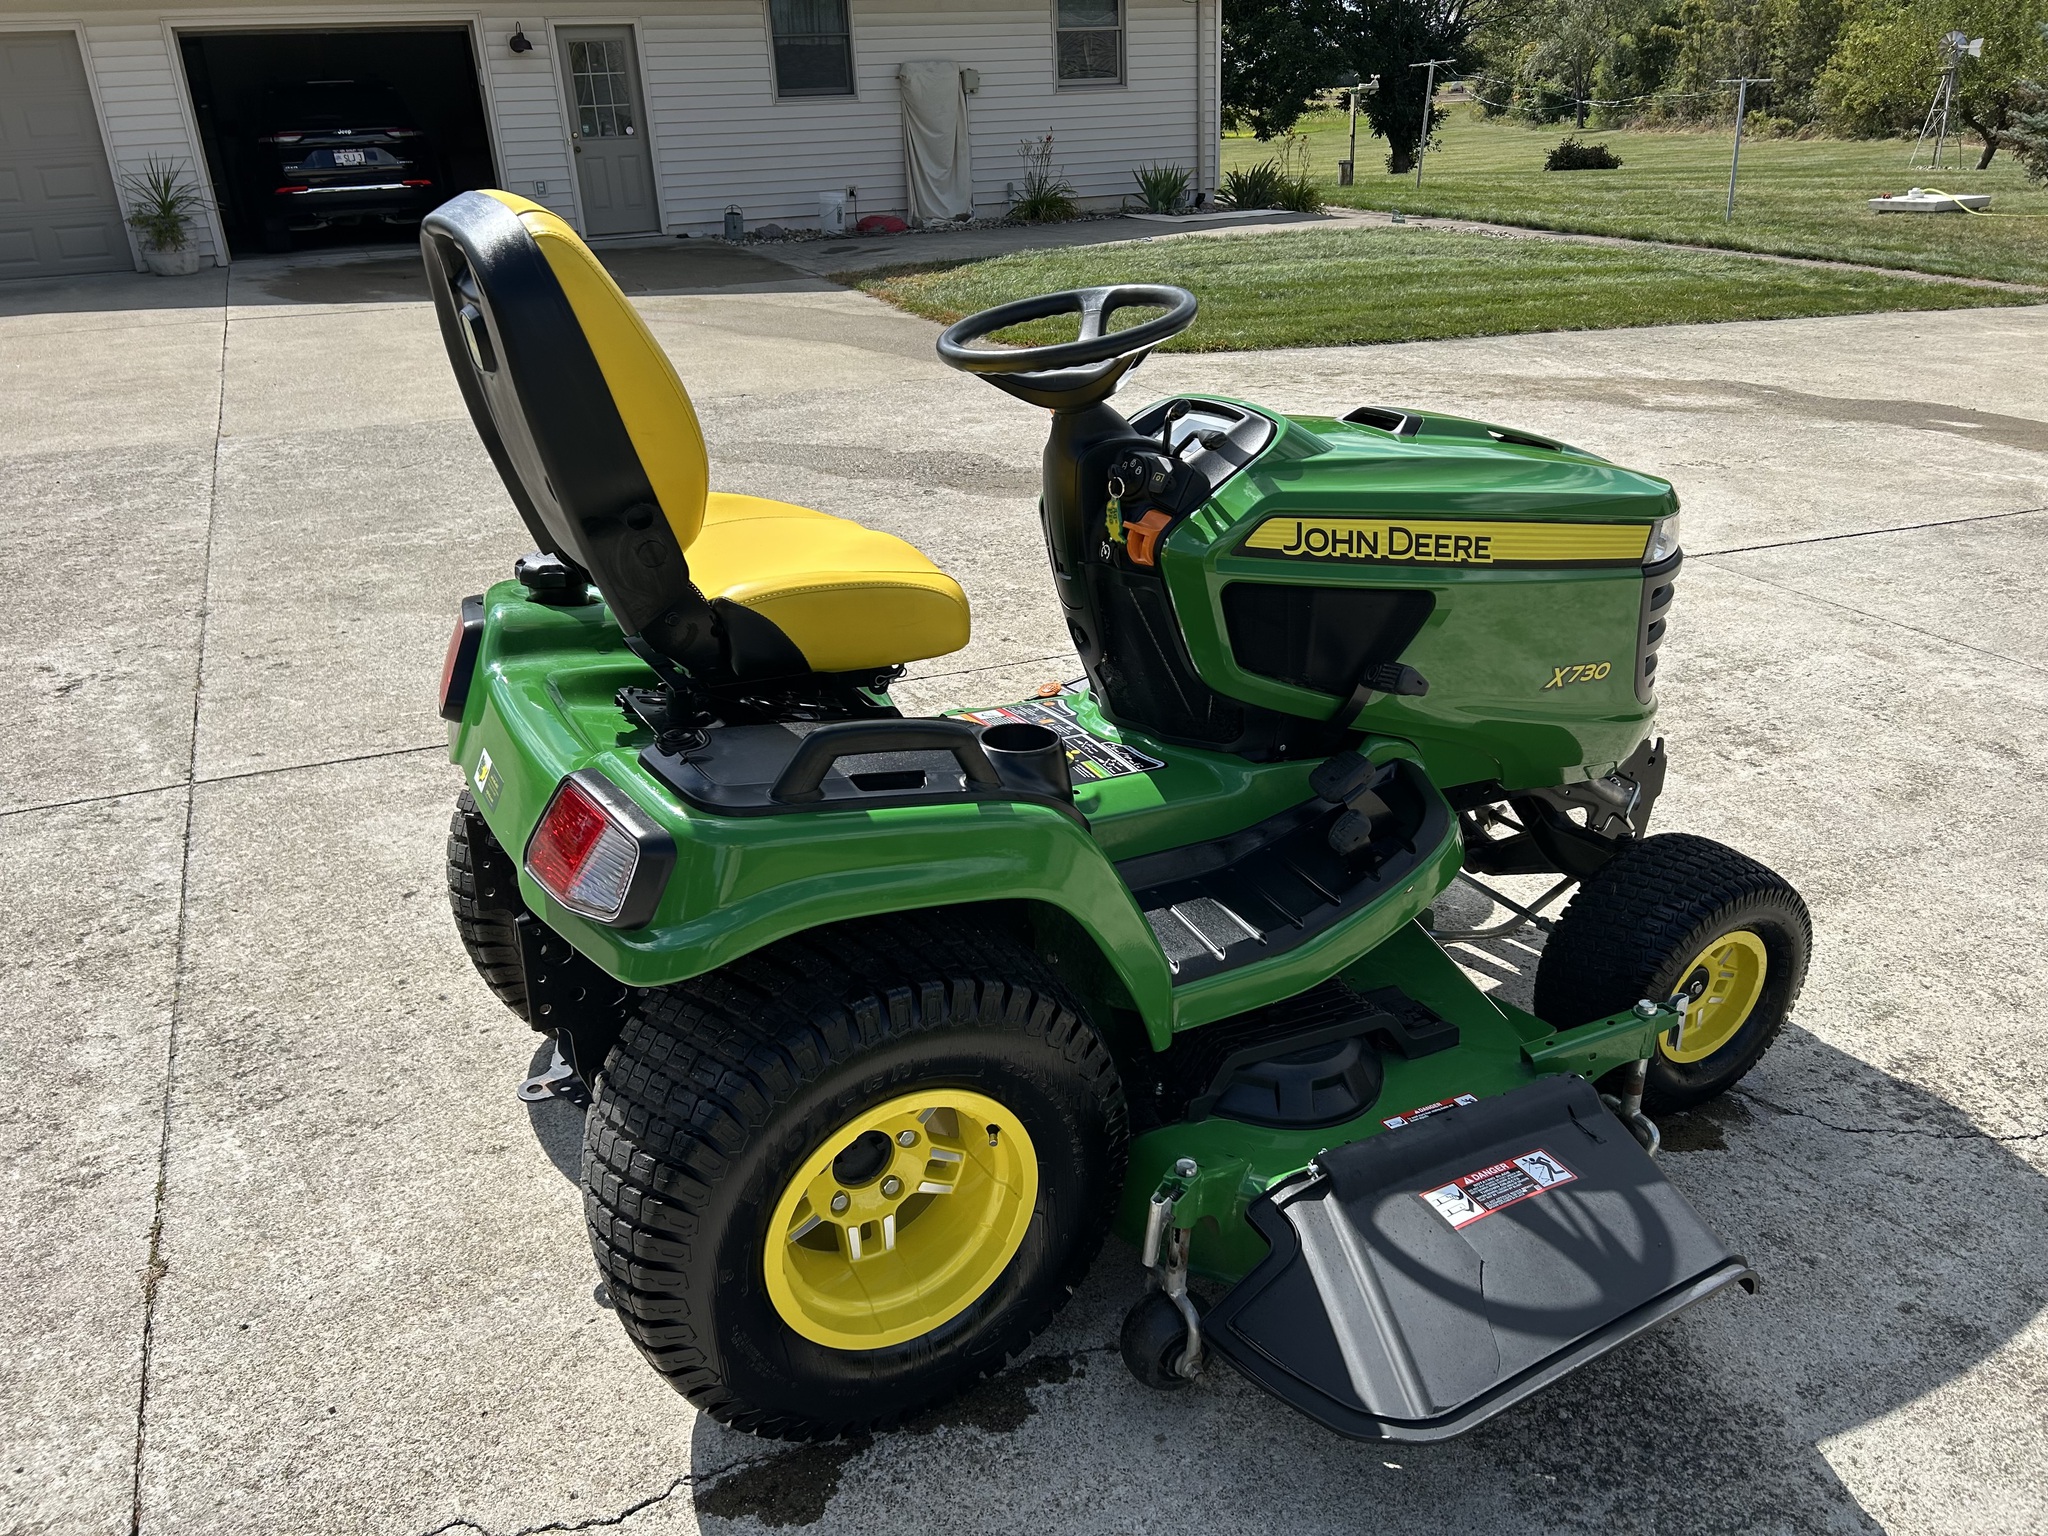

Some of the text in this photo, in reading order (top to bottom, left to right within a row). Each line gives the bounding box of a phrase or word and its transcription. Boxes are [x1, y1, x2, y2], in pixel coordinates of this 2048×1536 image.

[1283, 521, 1492, 560] JOHN DEERE
[1543, 661, 1612, 690] X730
[1417, 1101, 1443, 1113] DANGER
[1471, 1162, 1510, 1181] DANGER
